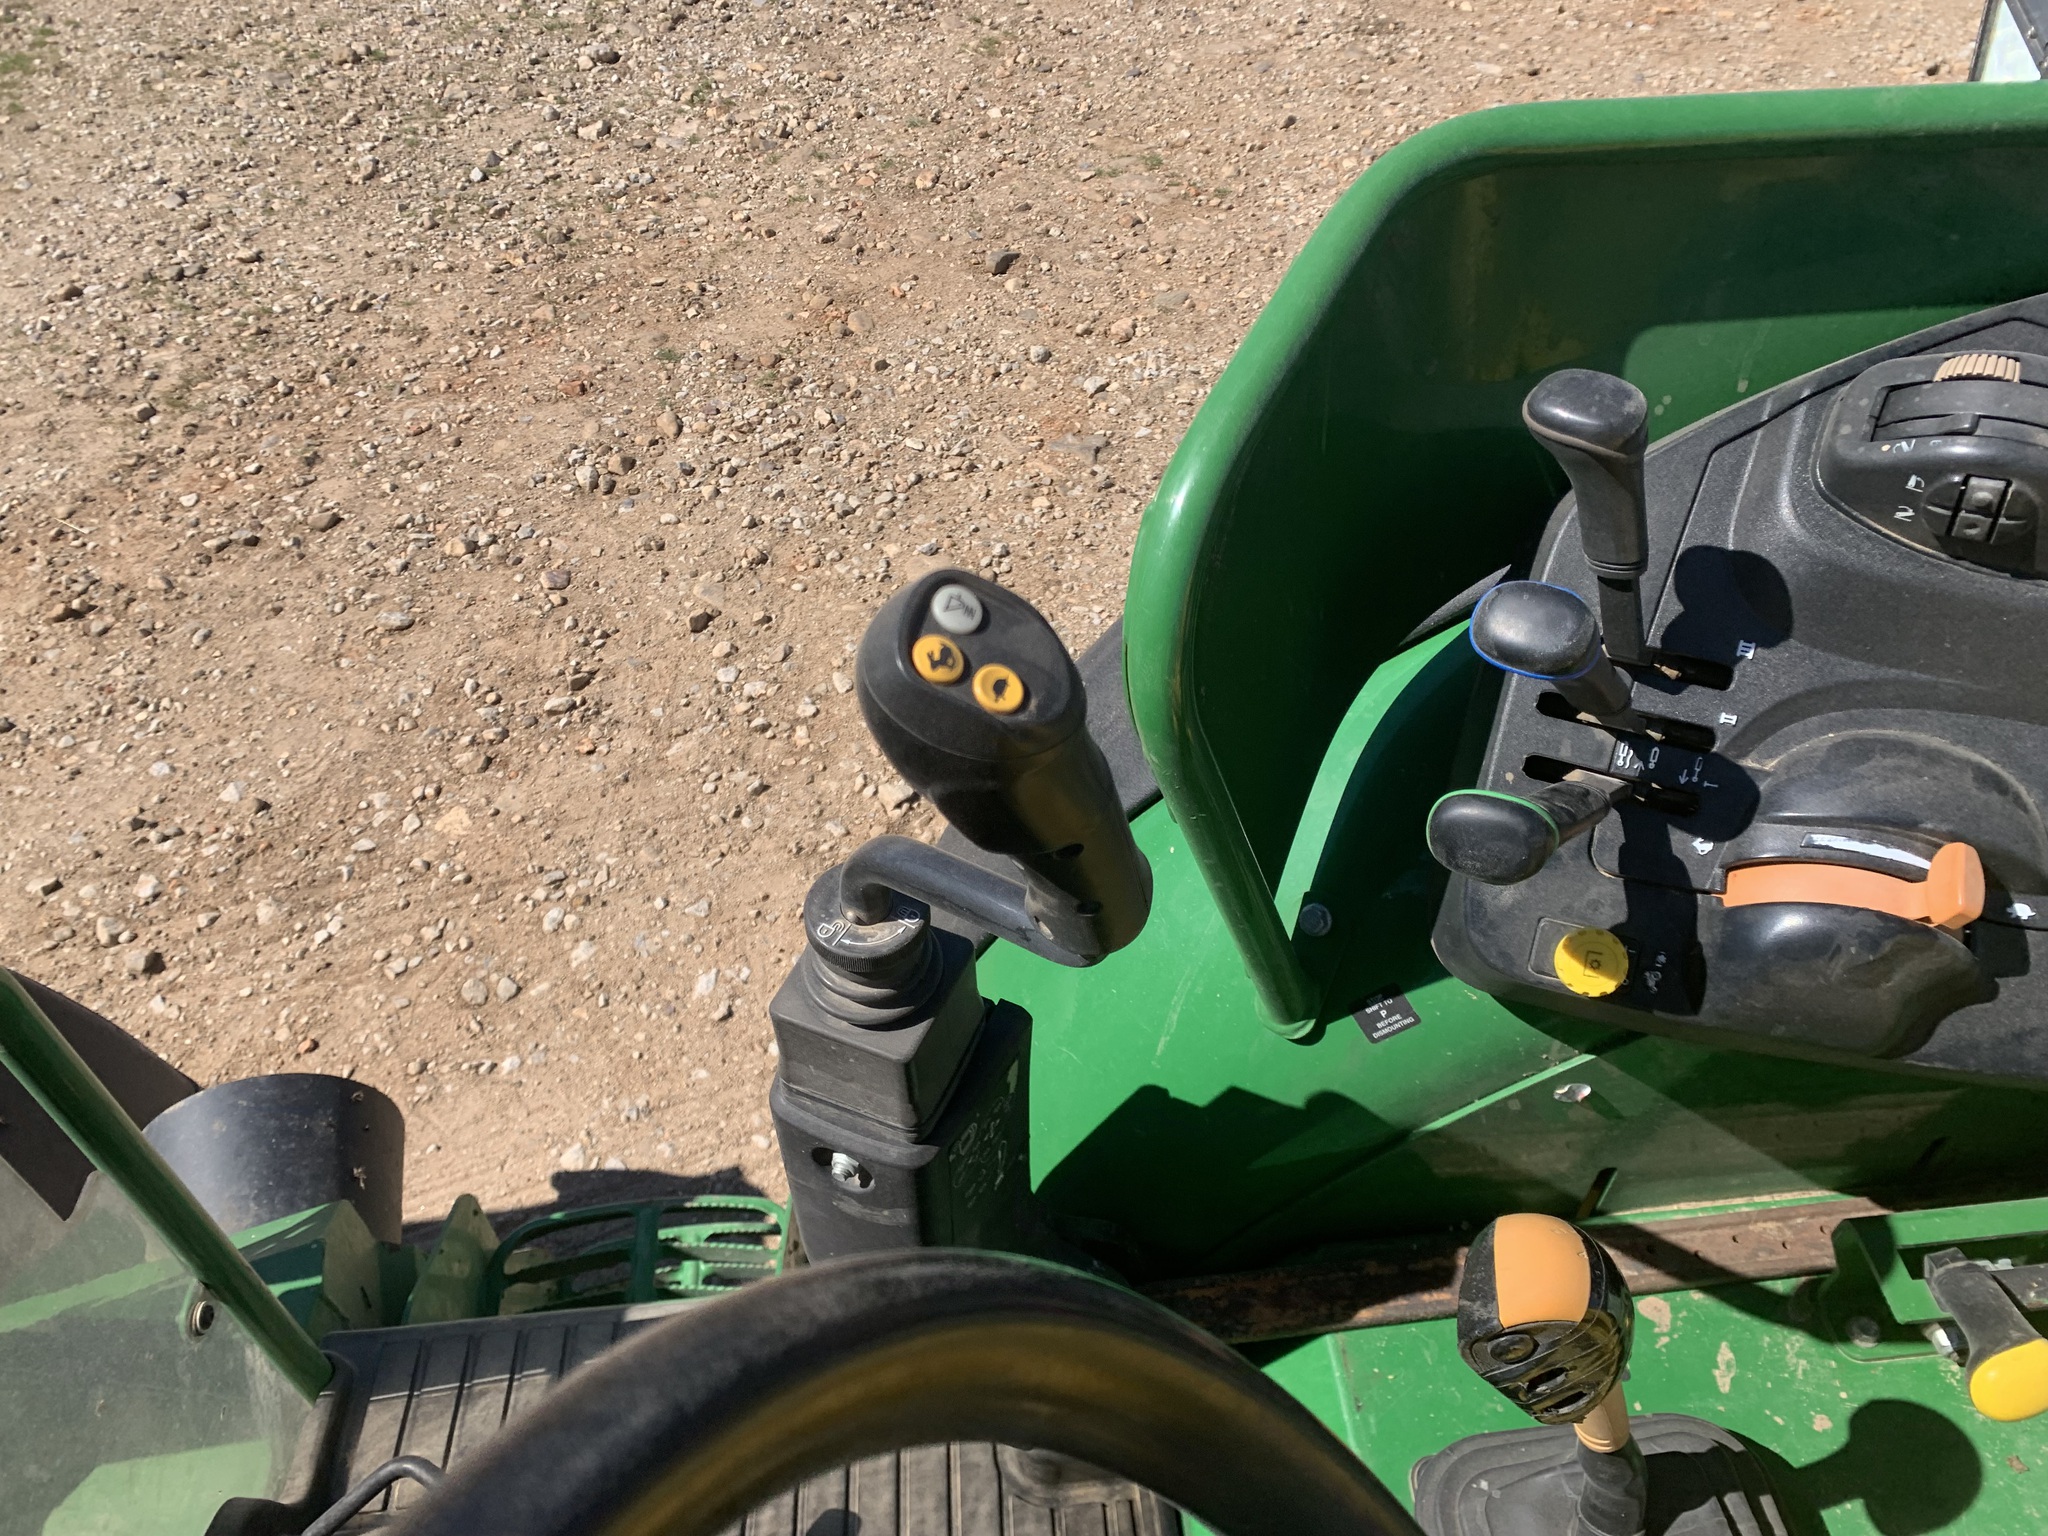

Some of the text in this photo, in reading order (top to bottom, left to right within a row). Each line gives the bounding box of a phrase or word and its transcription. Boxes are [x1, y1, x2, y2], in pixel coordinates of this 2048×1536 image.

[1365, 998, 1393, 1014] SHIFT TO
[1380, 1009, 1387, 1018] P
[1372, 1016, 1415, 1039] DISMOUNTING
[1376, 1014, 1402, 1029] BEFORE
